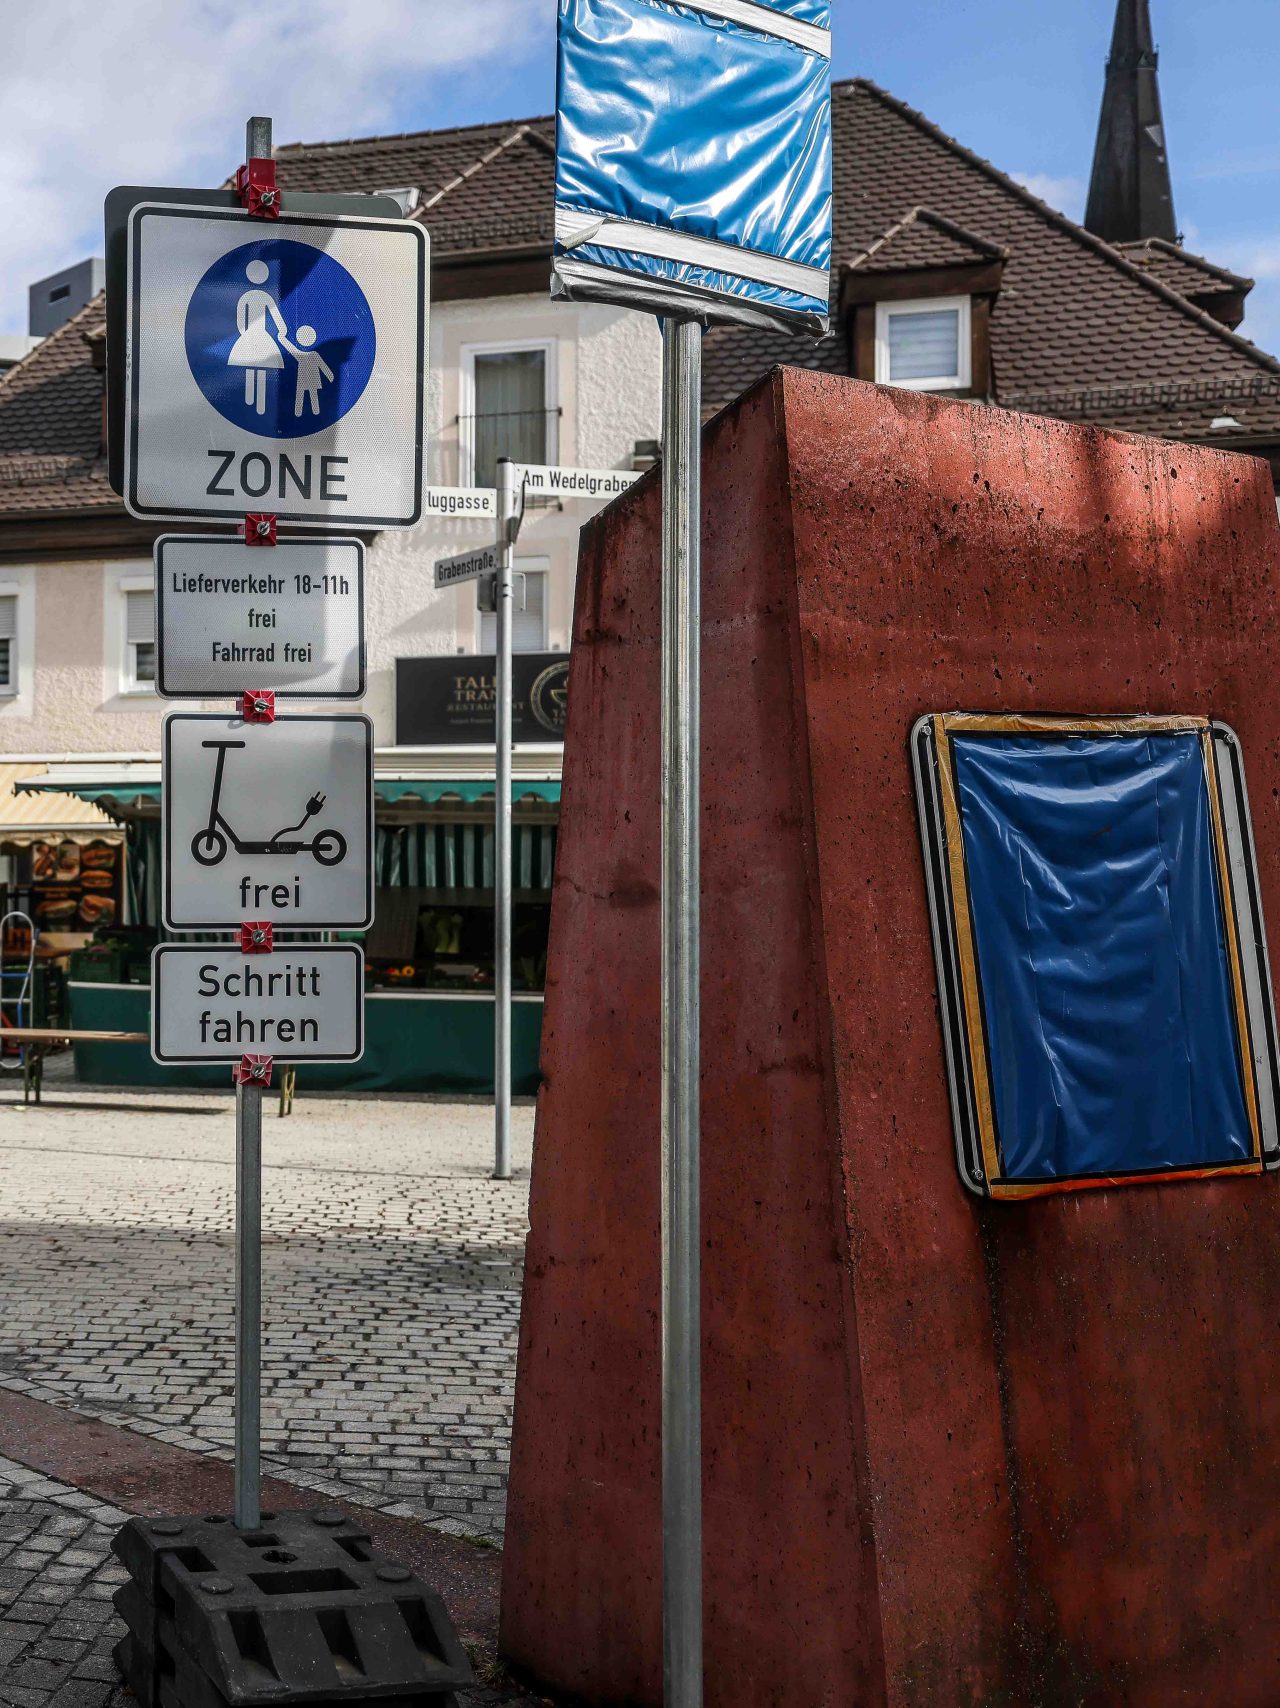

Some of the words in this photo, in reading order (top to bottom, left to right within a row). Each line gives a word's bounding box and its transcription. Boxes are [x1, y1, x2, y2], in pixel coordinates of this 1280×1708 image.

[206, 449, 349, 501] ZONE
[524, 469, 544, 487] Am
[428, 491, 489, 513] luggasse
[438, 551, 494, 581] Grabenstraße
[173, 573, 285, 593] Lieferverkehr
[294, 574, 349, 595] 18-11h
[248, 608, 276, 628] frei
[212, 641, 275, 662] Fahrrad
[284, 642, 312, 662] frei
[240, 876, 300, 908] frei
[197, 964, 321, 997] Schritt
[199, 1010, 319, 1043] fahren
